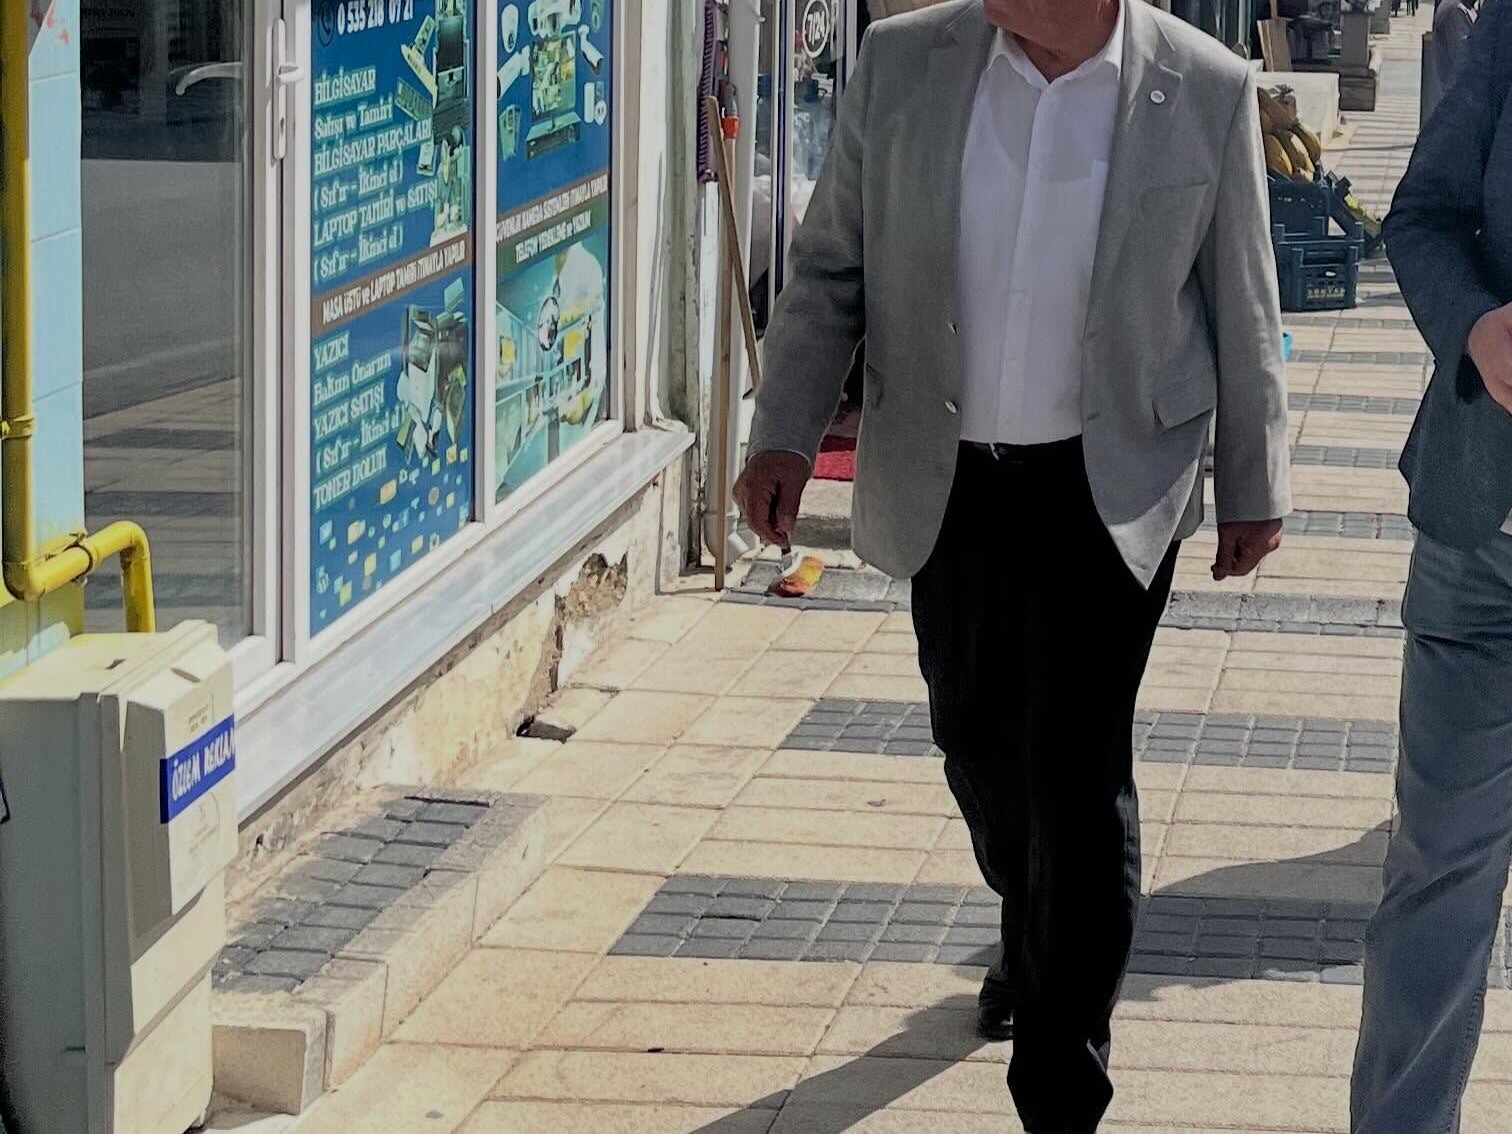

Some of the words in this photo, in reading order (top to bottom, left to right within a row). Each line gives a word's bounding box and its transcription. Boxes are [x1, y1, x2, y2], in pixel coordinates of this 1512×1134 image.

[347, 0, 366, 34] 535
[807, 11, 825, 45] 7/24
[314, 67, 376, 105] BİLGİSAYAR
[358, 93, 393, 126] Tamiri
[314, 138, 376, 176] BİLGİSAYAR
[377, 119, 432, 157] PARÇALARI
[314, 213, 357, 247] LAPTOP
[360, 191, 394, 228] TAMİRİ
[408, 179, 437, 208] SATIŞI
[323, 298, 343, 324] MASA
[371, 272, 396, 303] LAPTOP
[314, 333, 349, 370] YAZICI
[352, 353, 392, 383] Onarım
[314, 402, 350, 439] YAZICI
[351, 382, 385, 418] SATIŞI
[314, 468, 350, 508] TONER
[172, 758, 201, 802] ÖZLEM
